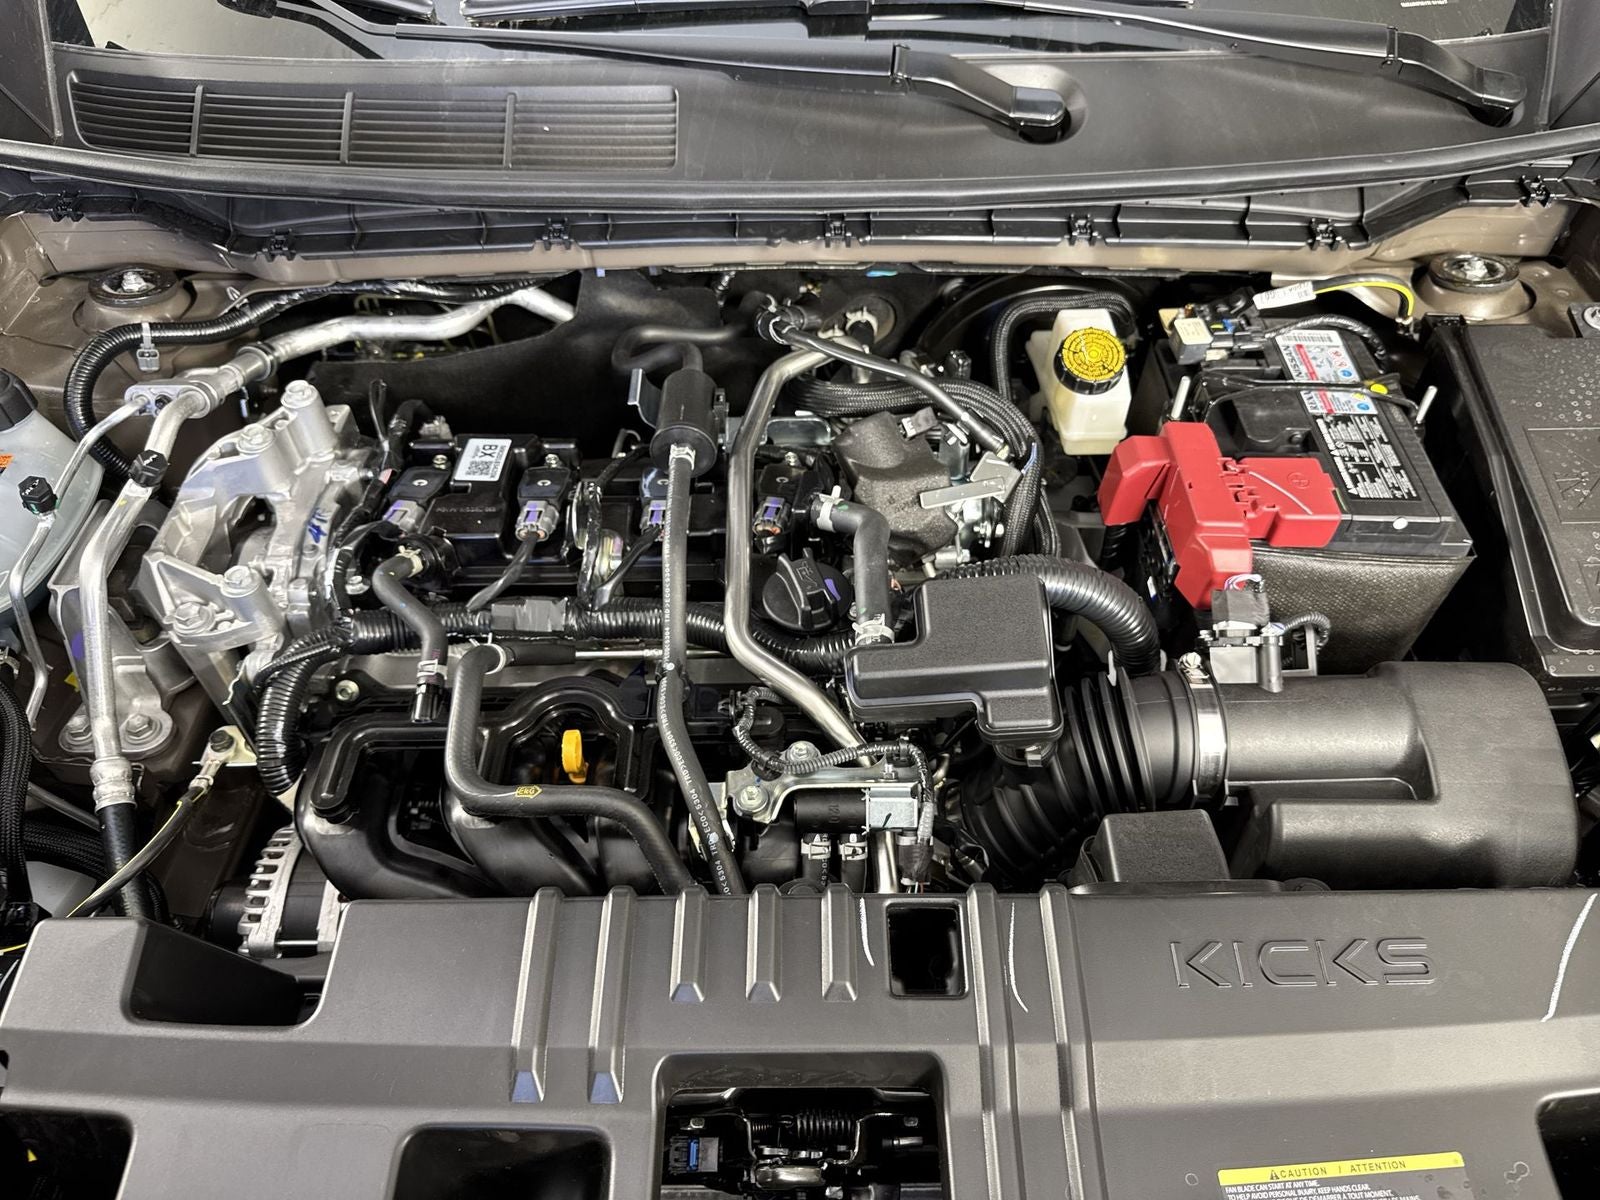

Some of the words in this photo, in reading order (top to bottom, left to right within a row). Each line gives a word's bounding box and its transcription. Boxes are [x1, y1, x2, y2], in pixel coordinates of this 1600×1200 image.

[1283, 344, 1305, 378] NISSAN
[479, 444, 499, 458] BX
[1170, 937, 1436, 989] KICKS
[1280, 1167, 1328, 1178] CAUTION
[1350, 1160, 1407, 1173] ATTENTION
[1225, 1186, 1237, 1194] FAN
[1237, 1185, 1255, 1193] BLADE
[1255, 1183, 1268, 1191] CAN
[1268, 1182, 1285, 1190] START
[1304, 1179, 1320, 1187] TIME.
[1251, 1191, 1269, 1199] AVOID
[1269, 1190, 1297, 1198] PERSONAL
[1331, 1185, 1351, 1193] HANDS
[1351, 1183, 1371, 1191] CLEAR.
[1348, 1191, 1363, 1199] TOUT
[1363, 1189, 1394, 1198] MOMENT.
